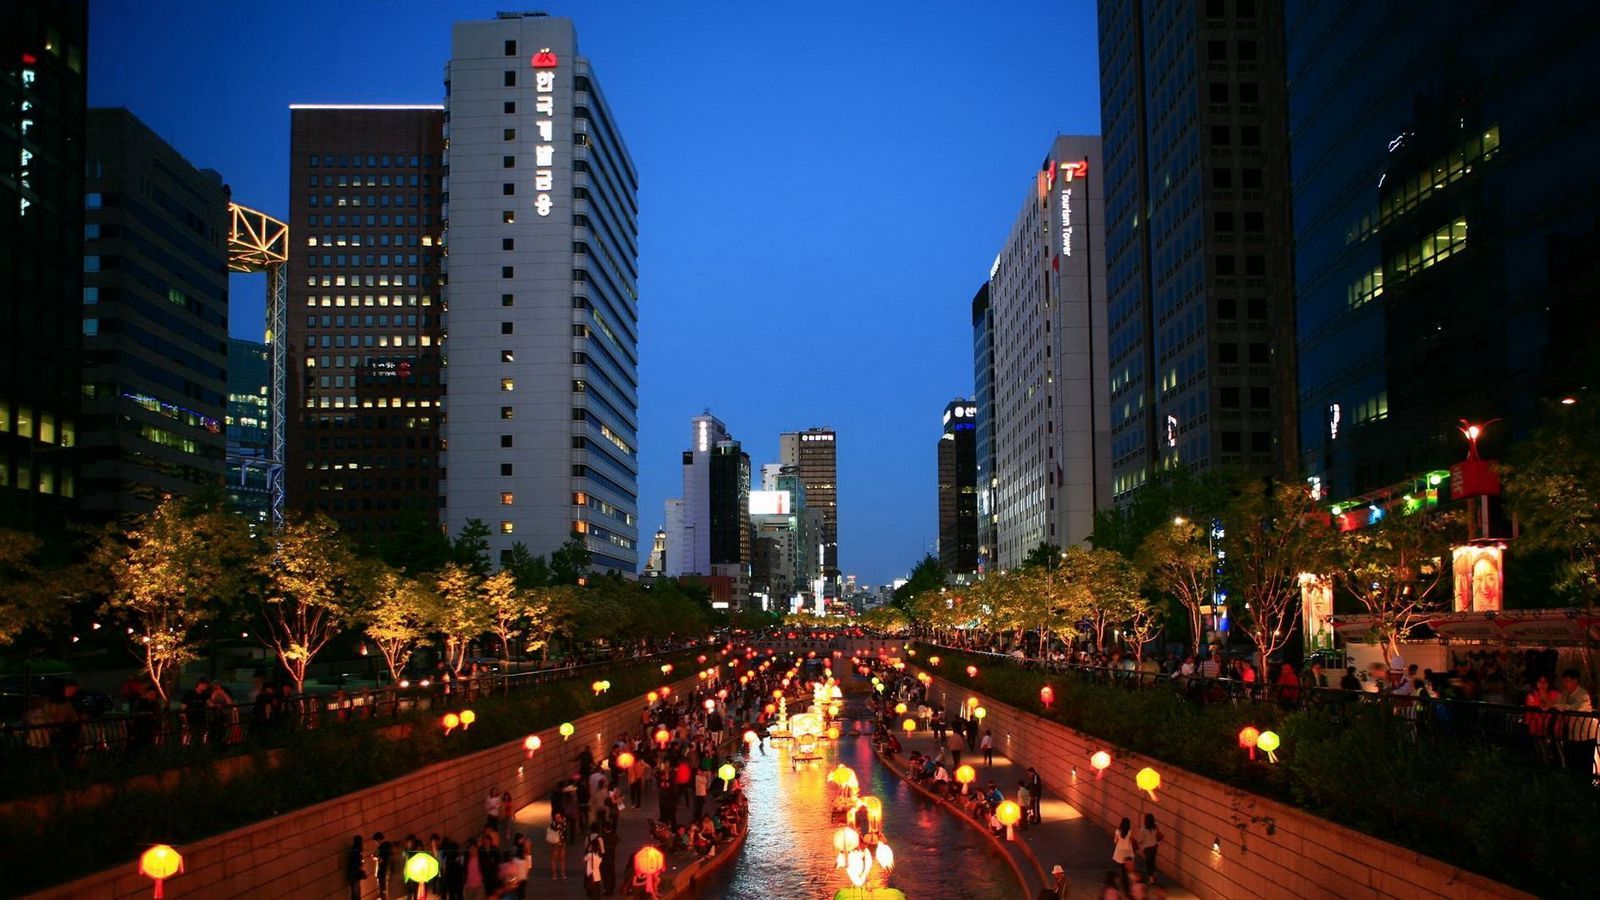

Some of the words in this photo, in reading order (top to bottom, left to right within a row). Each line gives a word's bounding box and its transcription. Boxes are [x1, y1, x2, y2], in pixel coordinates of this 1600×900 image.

[535, 71, 555, 216] 한국개발금융
[1060, 161, 1086, 182] T2
[1061, 188, 1072, 226] Tourism
[1062, 226, 1073, 257] Tower
